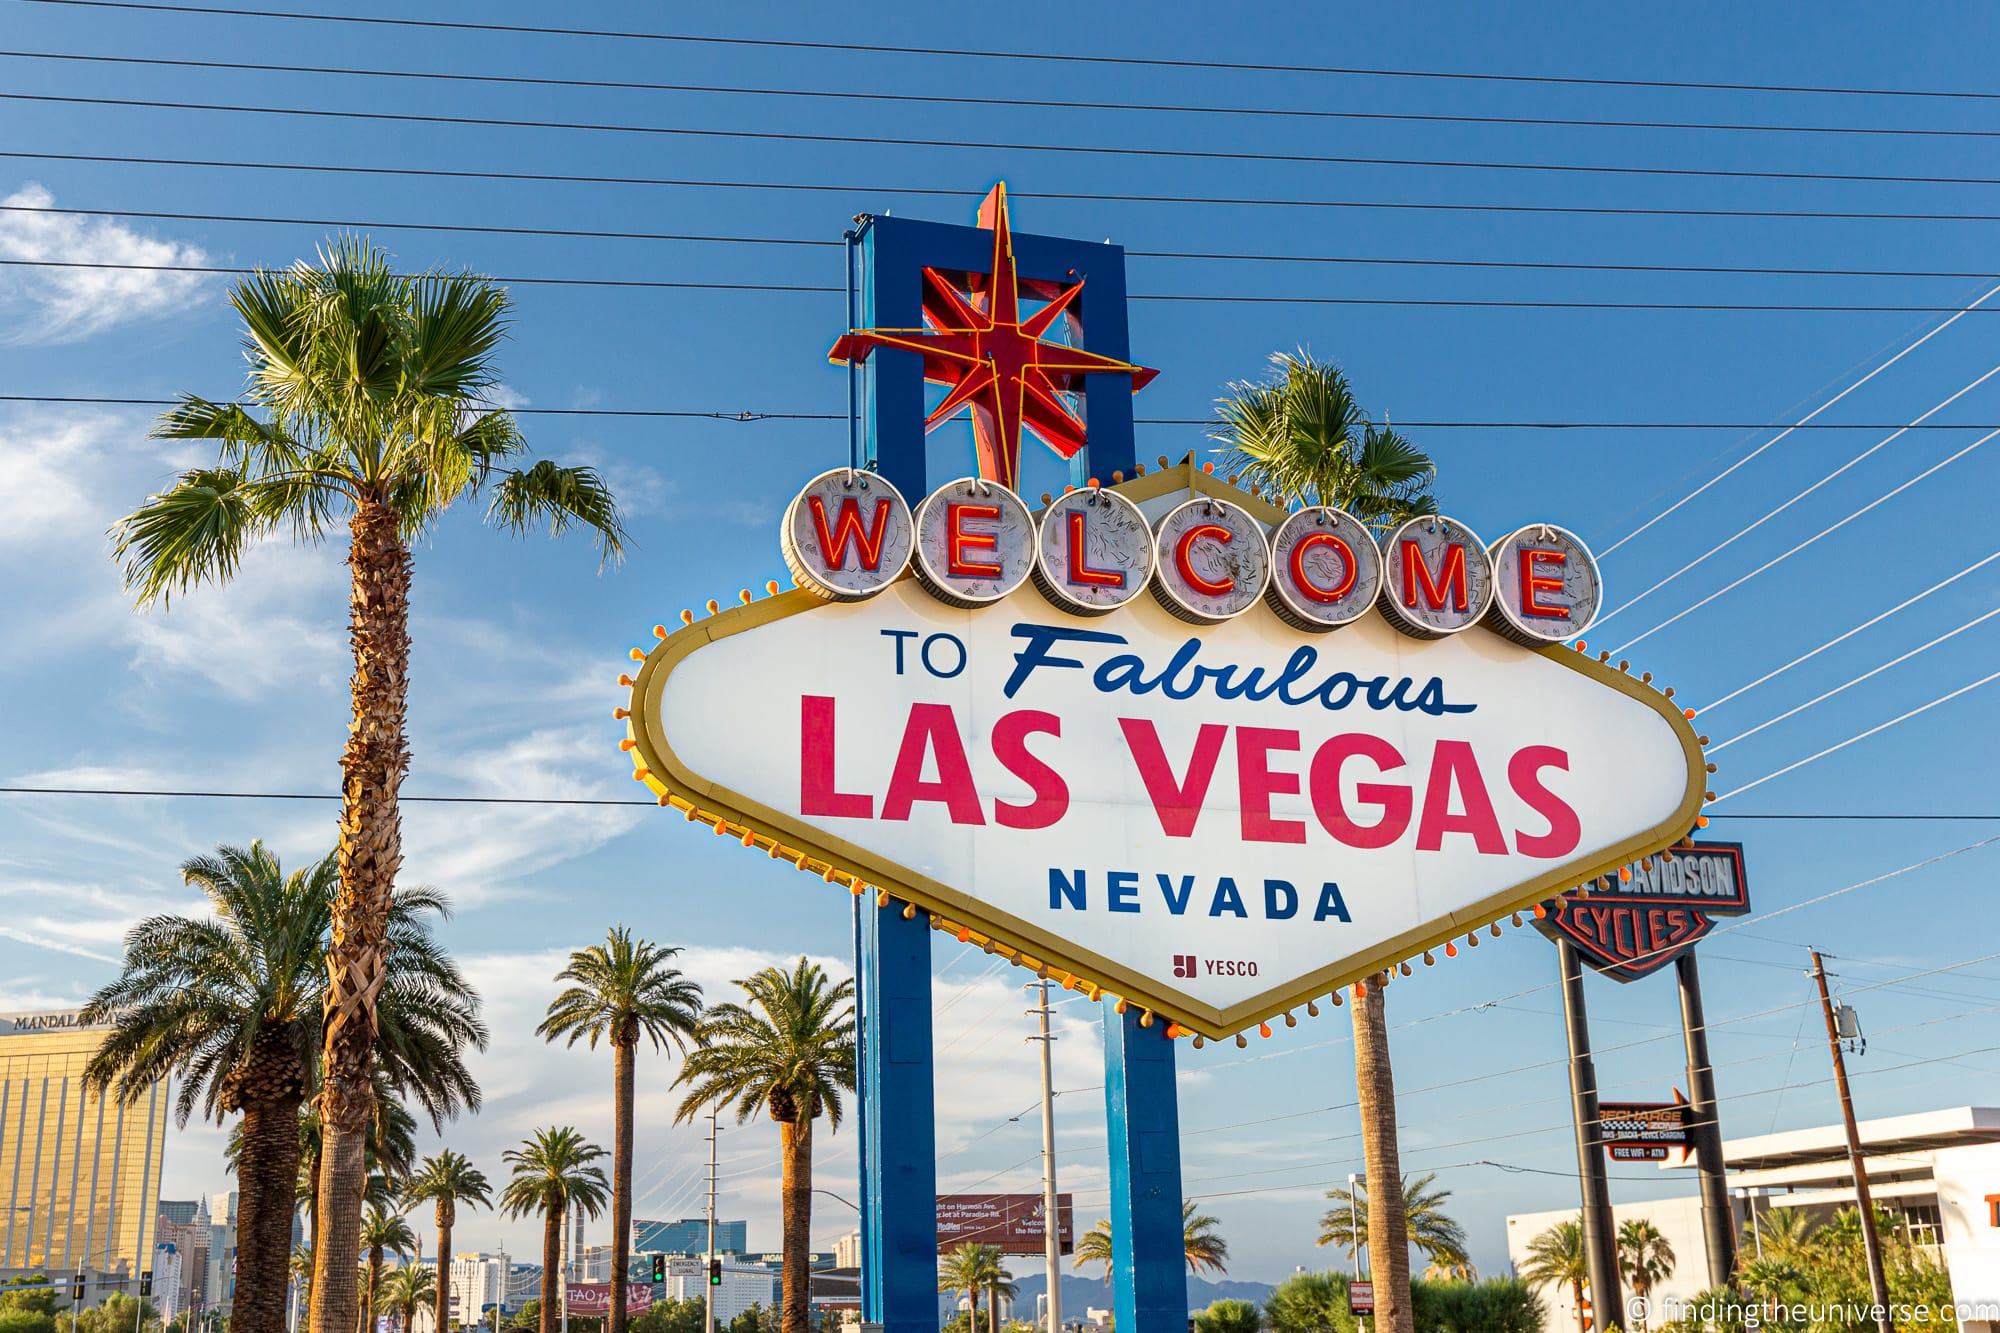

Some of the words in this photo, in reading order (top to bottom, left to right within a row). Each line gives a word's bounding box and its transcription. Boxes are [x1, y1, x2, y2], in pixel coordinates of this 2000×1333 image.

[810, 496, 1572, 619] WELCOME
[881, 629, 967, 678] TO
[1004, 624, 1478, 716] Fabulous
[801, 695, 1069, 829] LAS
[1119, 717, 1581, 858] VEGAS
[1049, 868, 1350, 923] NEVADA
[1573, 907, 1689, 957] CYCLES
[1205, 960, 1258, 976] YESCO
[1651, 1121, 1682, 1130] ZONE
[1614, 1148, 1630, 1157] FREE
[1651, 1148, 1665, 1158] ATM
[961, 1211, 989, 1219] Paradise
[566, 1289, 596, 1301] TAO
